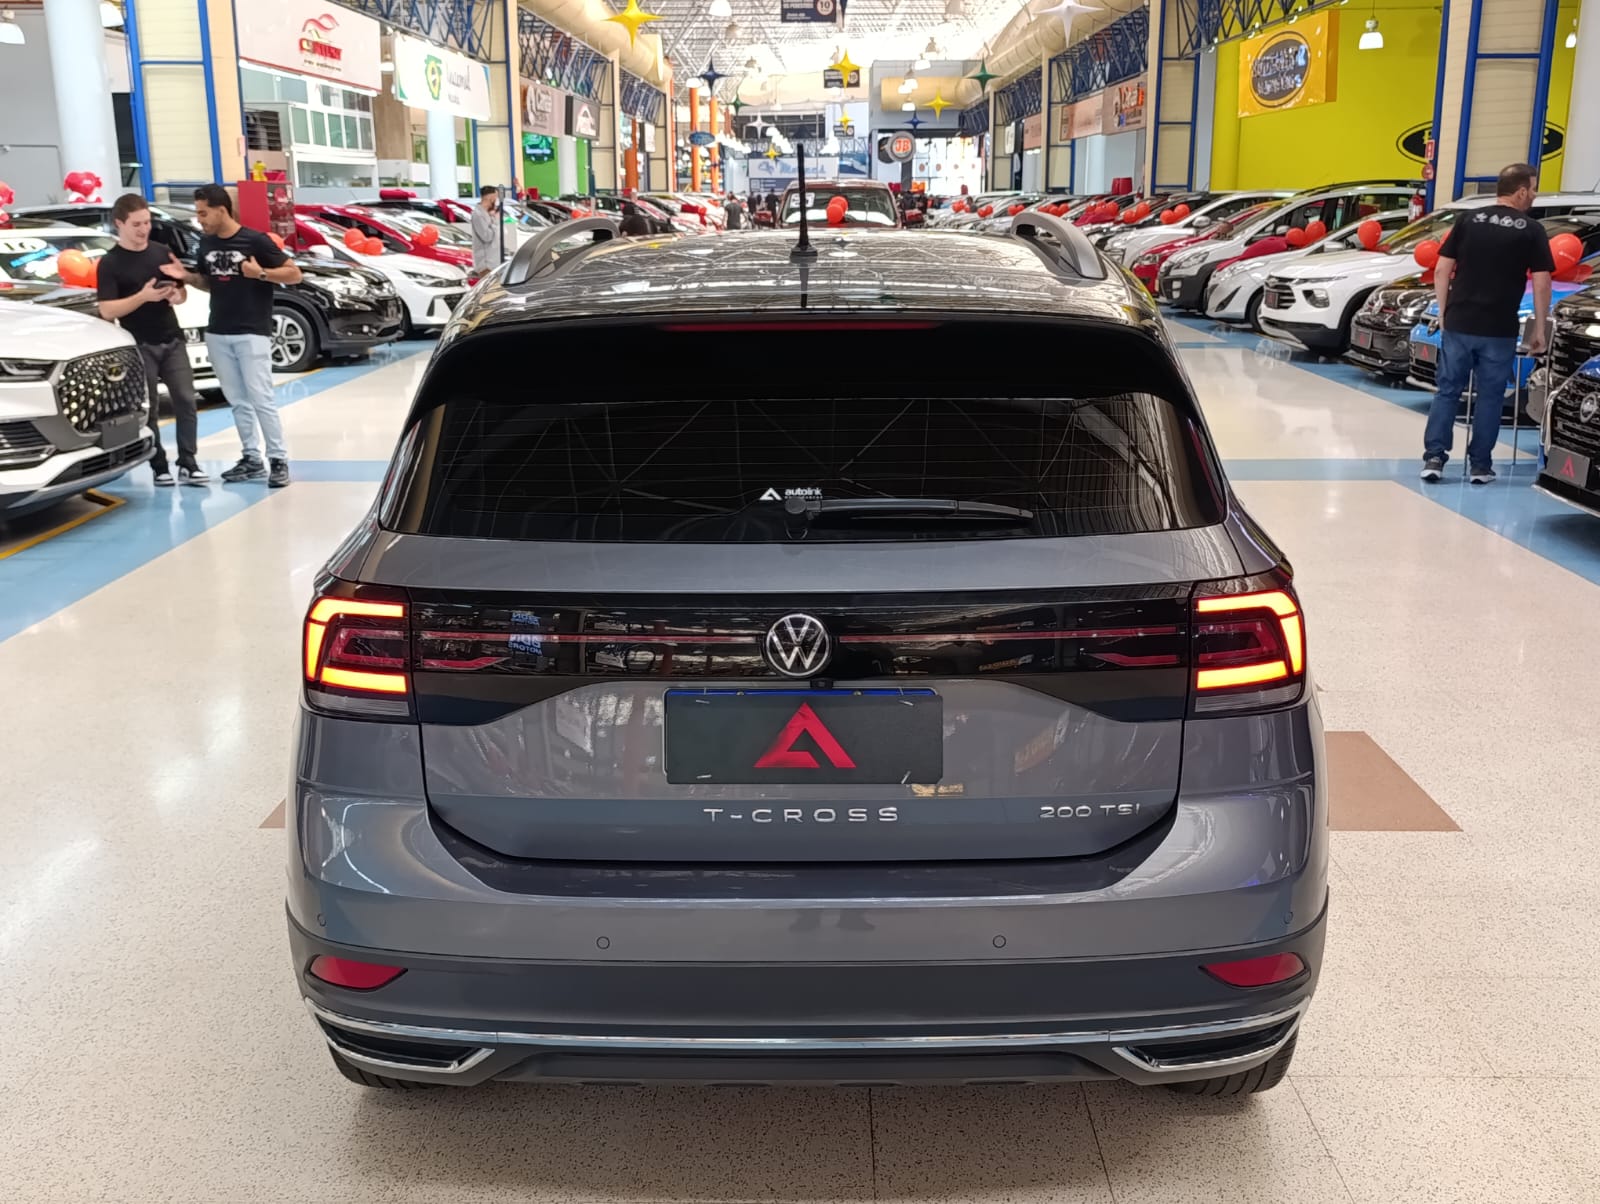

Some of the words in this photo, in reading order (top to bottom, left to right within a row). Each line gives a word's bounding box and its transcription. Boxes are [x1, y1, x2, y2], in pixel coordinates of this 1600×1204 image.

[784, 487, 823, 496] autolink
[703, 806, 899, 823] T-CROSS
[1039, 805, 1092, 818] 200
[1099, 803, 1140, 816] TSI
